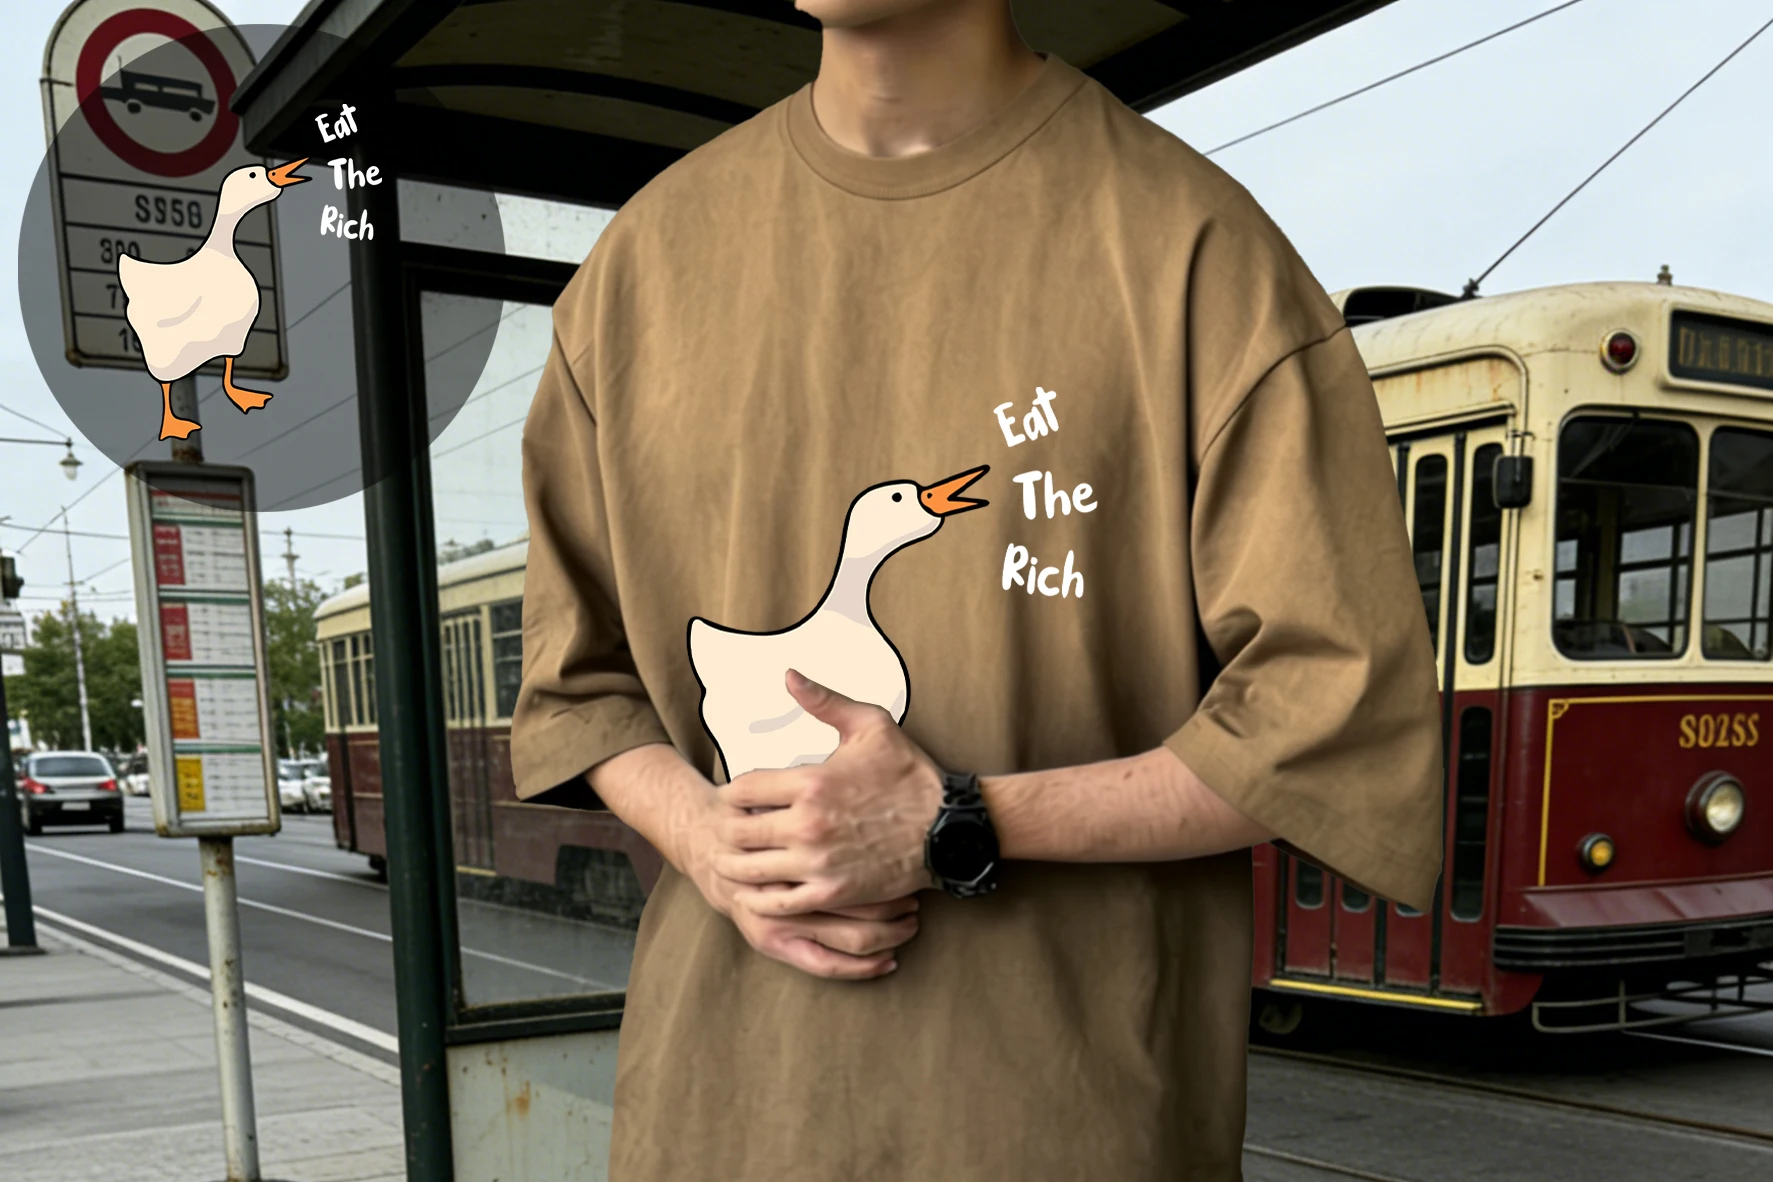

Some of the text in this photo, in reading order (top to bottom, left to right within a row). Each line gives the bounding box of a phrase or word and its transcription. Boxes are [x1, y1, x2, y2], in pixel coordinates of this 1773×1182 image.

[993, 386, 1059, 447] Eat
[1012, 470, 1098, 520] The
[1002, 543, 1084, 598] Rich
